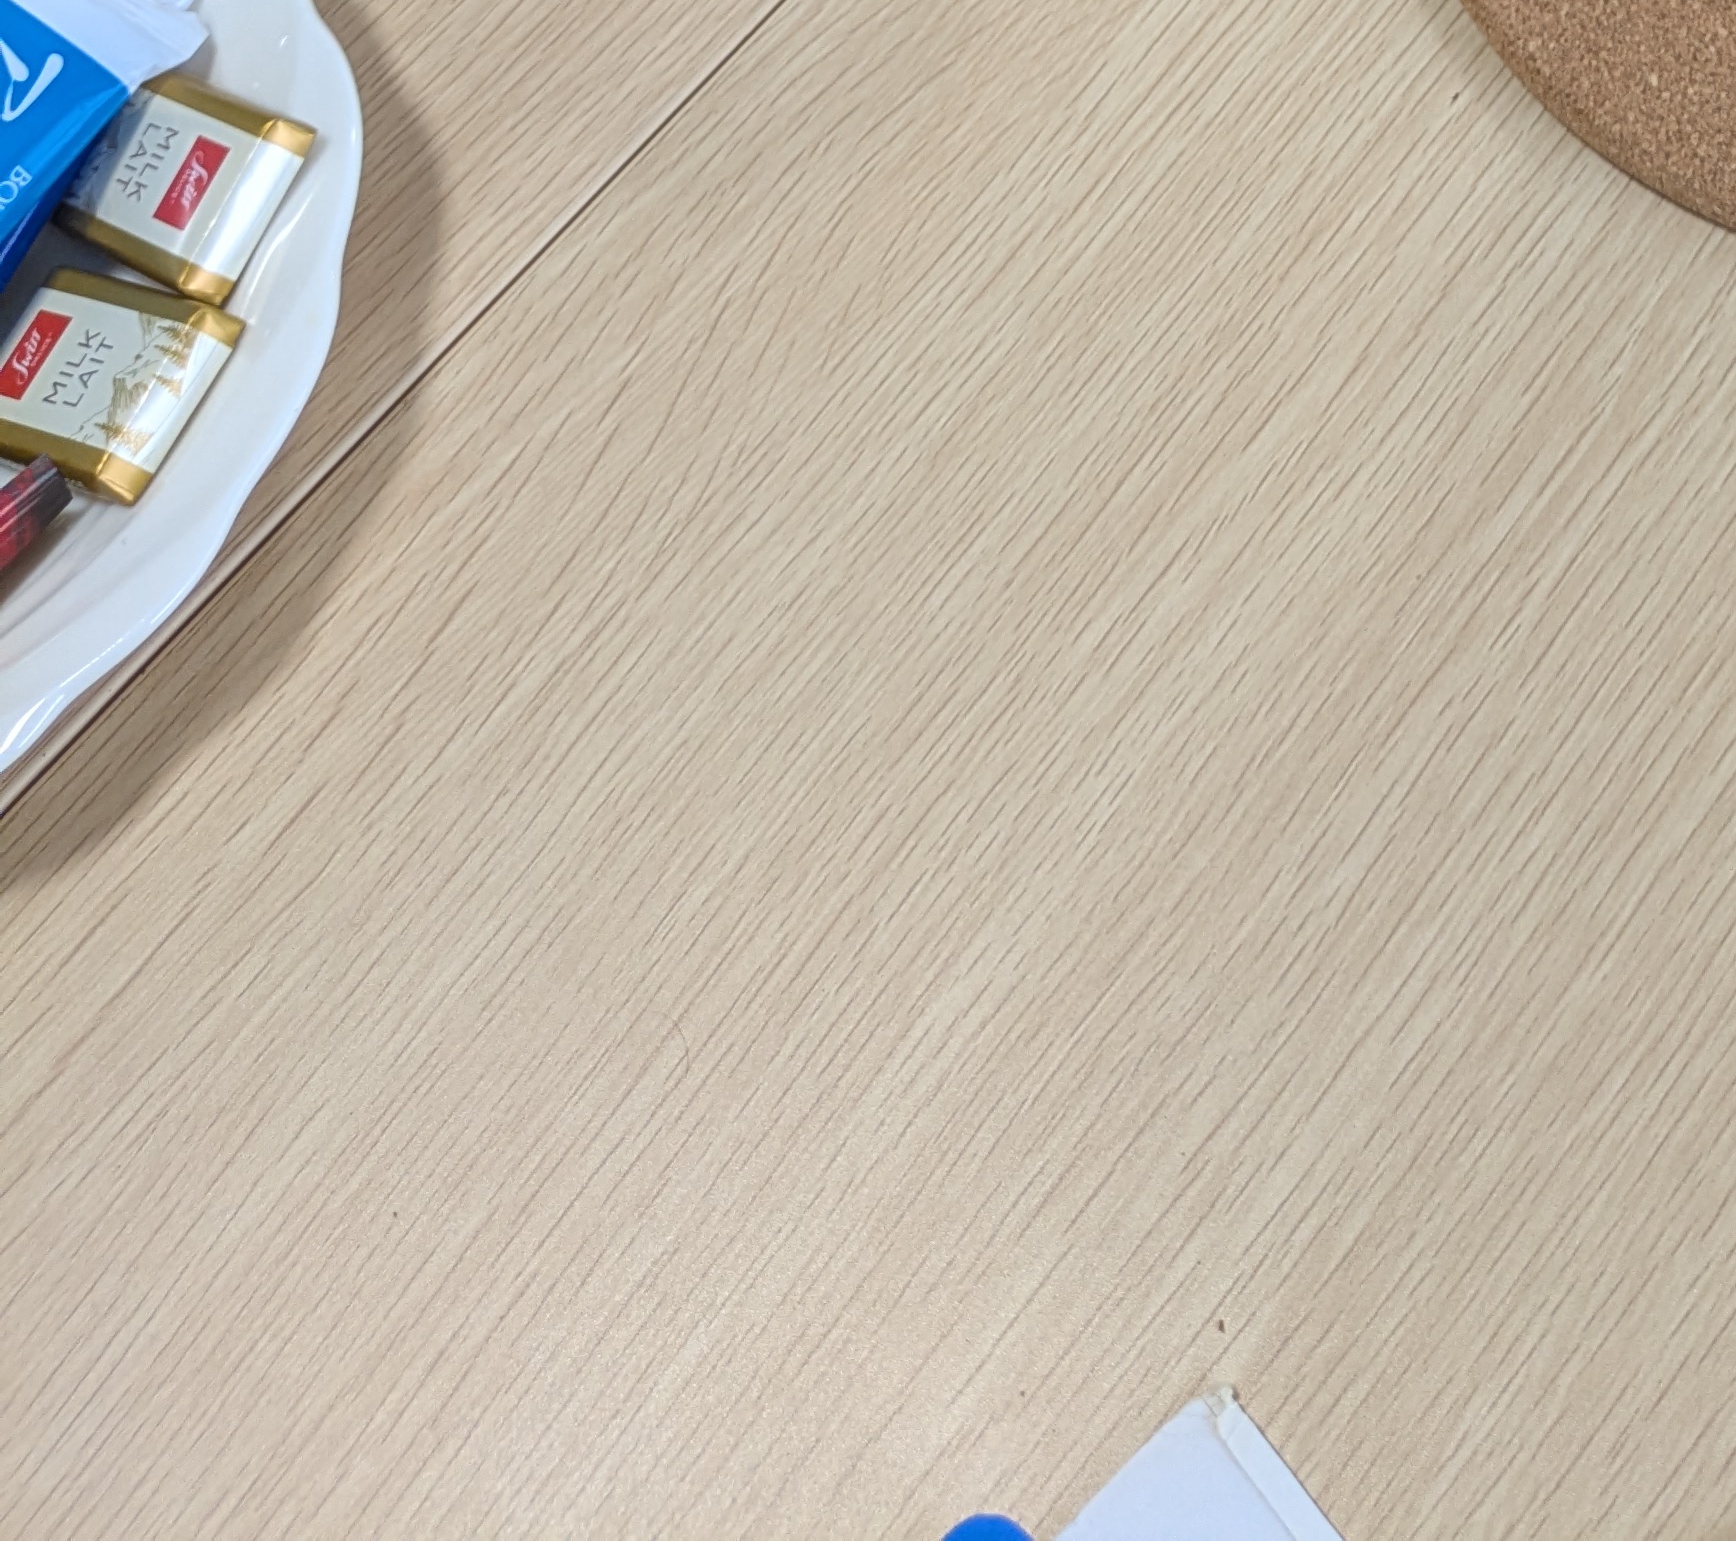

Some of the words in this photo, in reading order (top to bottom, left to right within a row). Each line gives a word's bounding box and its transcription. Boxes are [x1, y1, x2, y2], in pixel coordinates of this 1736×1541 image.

[116, 123, 162, 193] LAIT
[127, 126, 180, 203] MILK
[42, 328, 101, 405] MILK
[62, 336, 115, 408] LAIT
